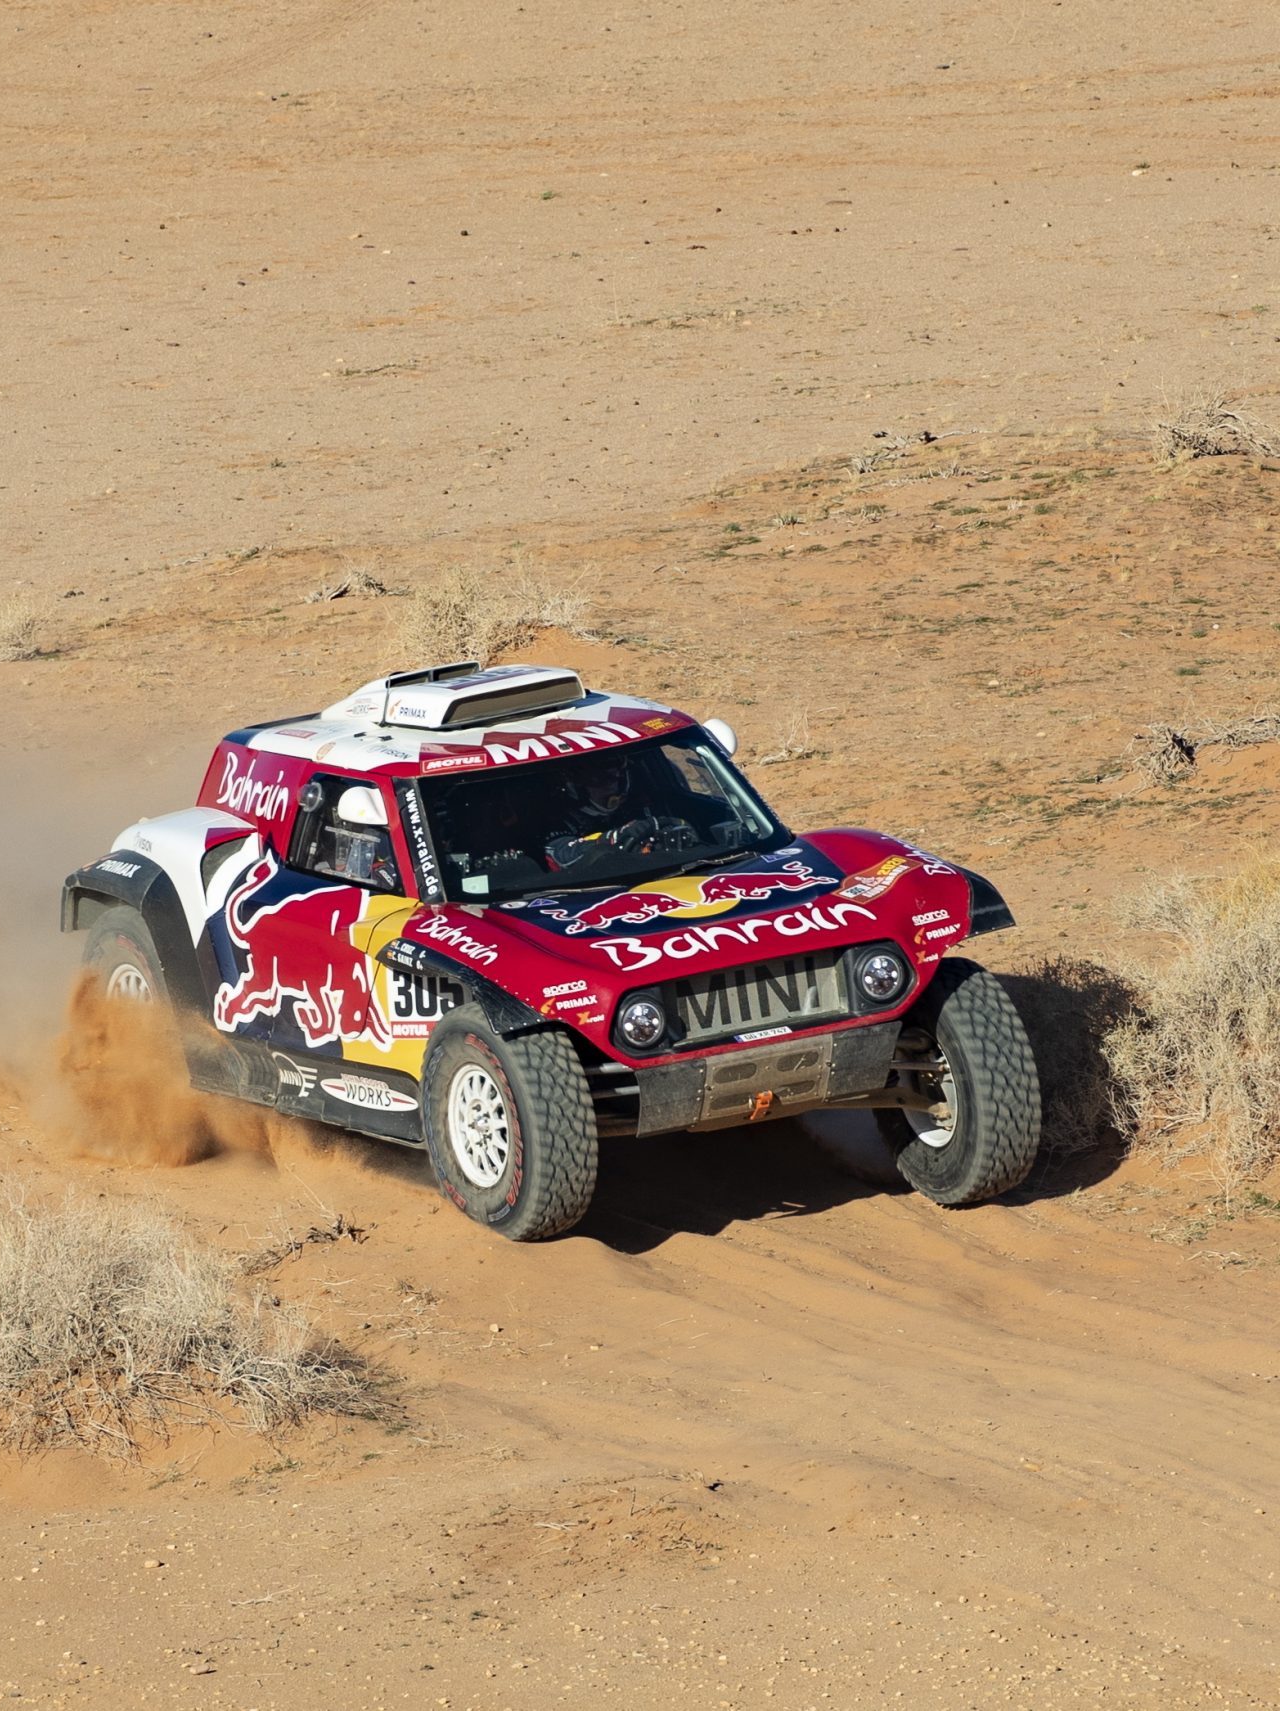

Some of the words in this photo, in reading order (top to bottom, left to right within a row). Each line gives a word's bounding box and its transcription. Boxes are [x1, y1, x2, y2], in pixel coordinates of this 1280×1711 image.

[399, 706, 427, 719] PRIMAX
[483, 721, 642, 765] MINI
[426, 756, 483, 770] MOTUL
[216, 752, 289, 822] Bahrain
[405, 788, 439, 896] www.x-raid.de
[96, 859, 141, 878] PRIMAX
[912, 909, 950, 926] sparco
[416, 914, 499, 966] Bahrain
[590, 902, 877, 971] Bahrain
[392, 968, 465, 1017] 305
[542, 980, 587, 998] sparco
[675, 956, 821, 1032] MINI
[556, 994, 598, 1010] PRIMAX
[393, 1024, 430, 1036] MOTUL
[279, 1068, 303, 1087] MINI
[345, 1082, 393, 1107] WORKS
